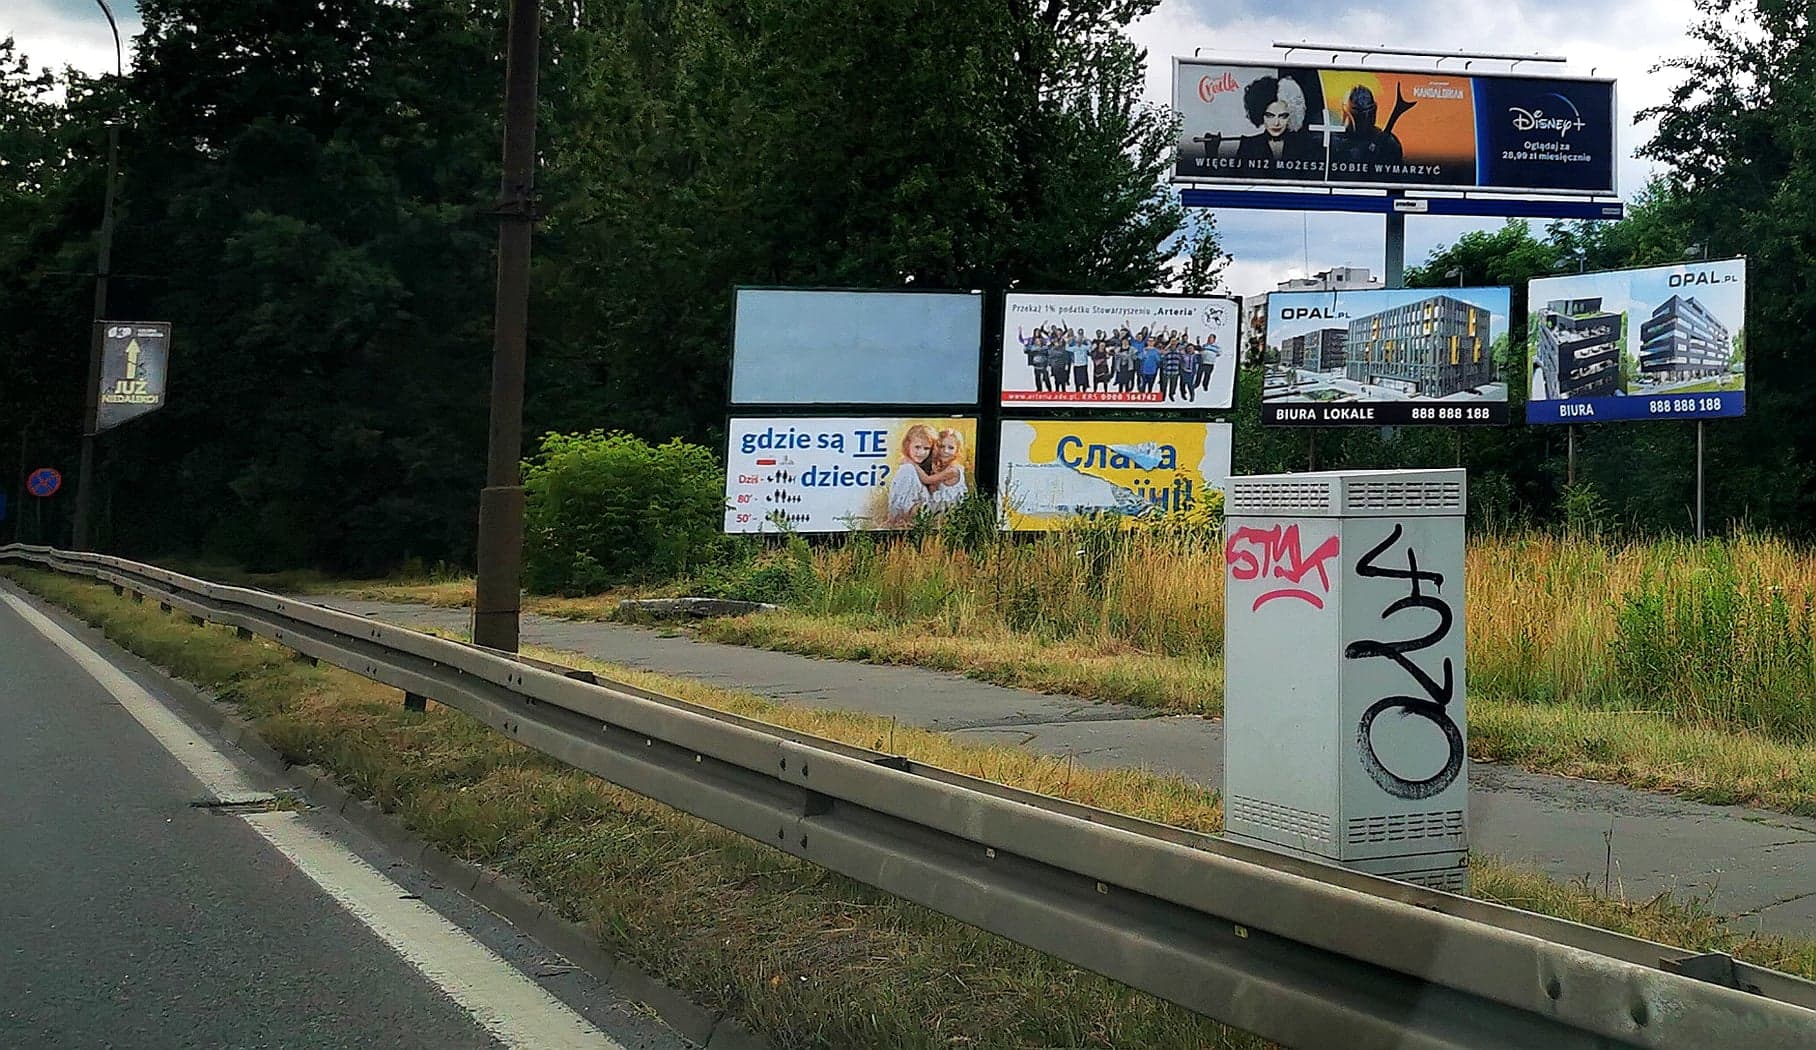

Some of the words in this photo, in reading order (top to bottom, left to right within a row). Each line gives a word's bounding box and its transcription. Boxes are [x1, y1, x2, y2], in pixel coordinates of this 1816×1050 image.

[1195, 158, 1242, 170] WIĘCEJ
[1276, 160, 1325, 171] MOŻESZ
[1331, 162, 1369, 172] SOBIE
[1374, 163, 1441, 175] WYMARZYĆ
[1059, 304, 1090, 315] podatku
[1082, 392, 1098, 401] KRS
[1559, 403, 1594, 417] BIURA
[1650, 400, 1671, 413] 888
[1674, 399, 1696, 412] 888
[1700, 397, 1721, 411] 188
[1276, 408, 1317, 420] BIURA
[1323, 408, 1375, 420] LOKALE
[1412, 408, 1435, 419] 888
[1439, 408, 1462, 419] 888
[1466, 408, 1490, 419] 188
[741, 427, 811, 454] gdzie
[817, 432, 844, 453] są
[853, 430, 888, 453] TE
[1057, 434, 1177, 470] Слаа
[801, 464, 890, 487] dzieci?
